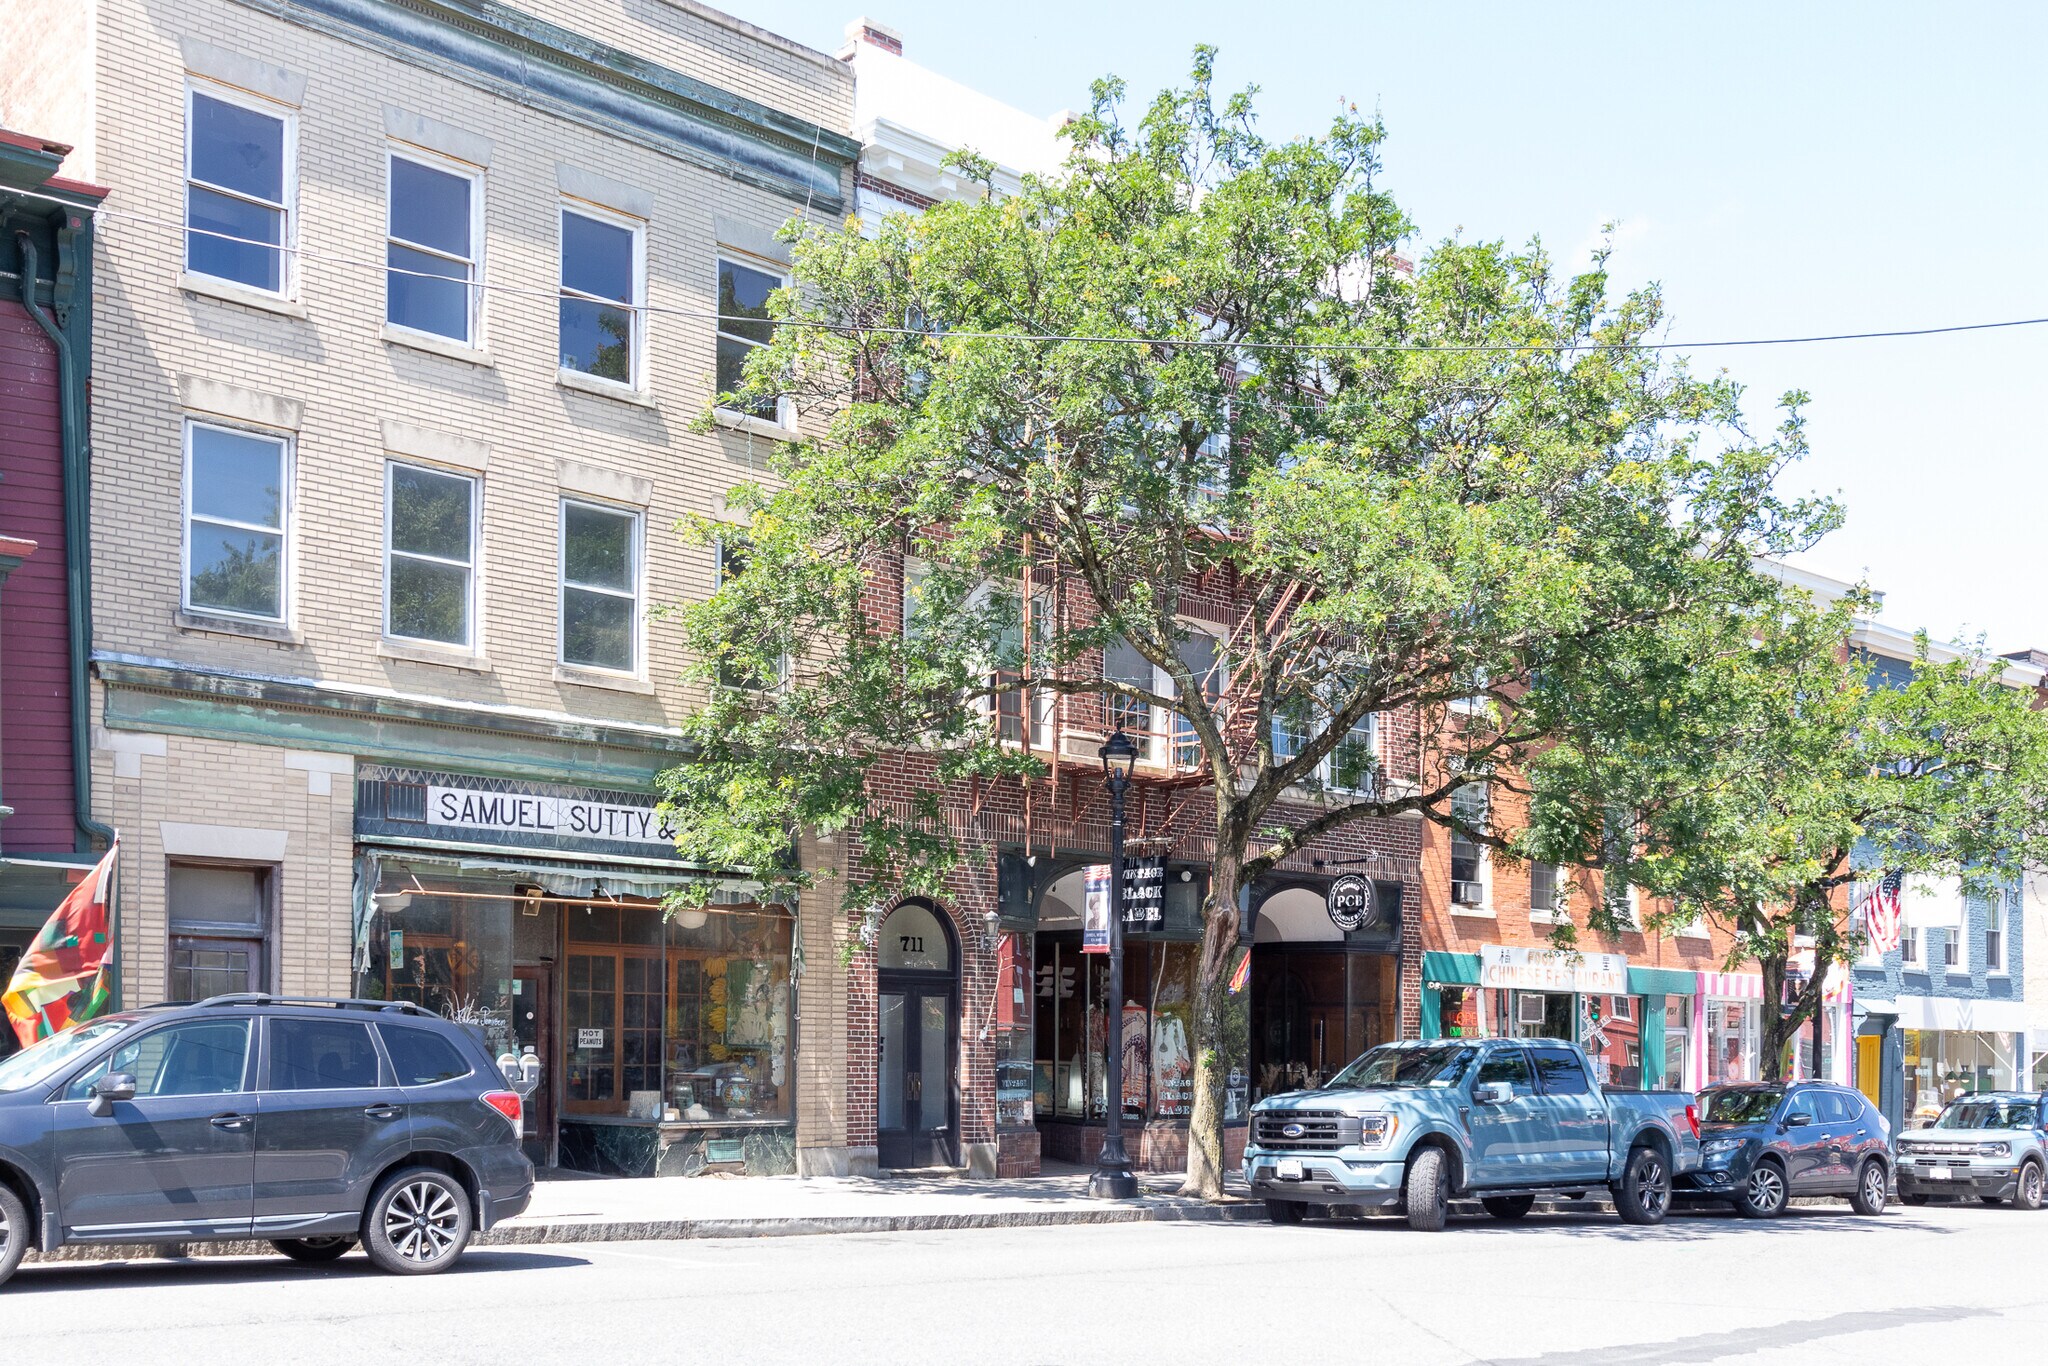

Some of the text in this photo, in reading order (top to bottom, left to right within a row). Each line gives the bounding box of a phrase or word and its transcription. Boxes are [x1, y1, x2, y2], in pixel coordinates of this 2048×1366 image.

[440, 792, 676, 840] SAMUEL SUTTY &
[1337, 894, 1363, 907] PCB
[900, 936, 924, 952] 711
[1488, 963, 1622, 992] CHINESE RESTAURANT
[1456, 1011, 1477, 1026] OPE
[579, 1037, 602, 1045] PEANUTS
[1160, 1079, 1193, 1087] VINTAG
[1095, 1096, 1139, 1106] CHLES
